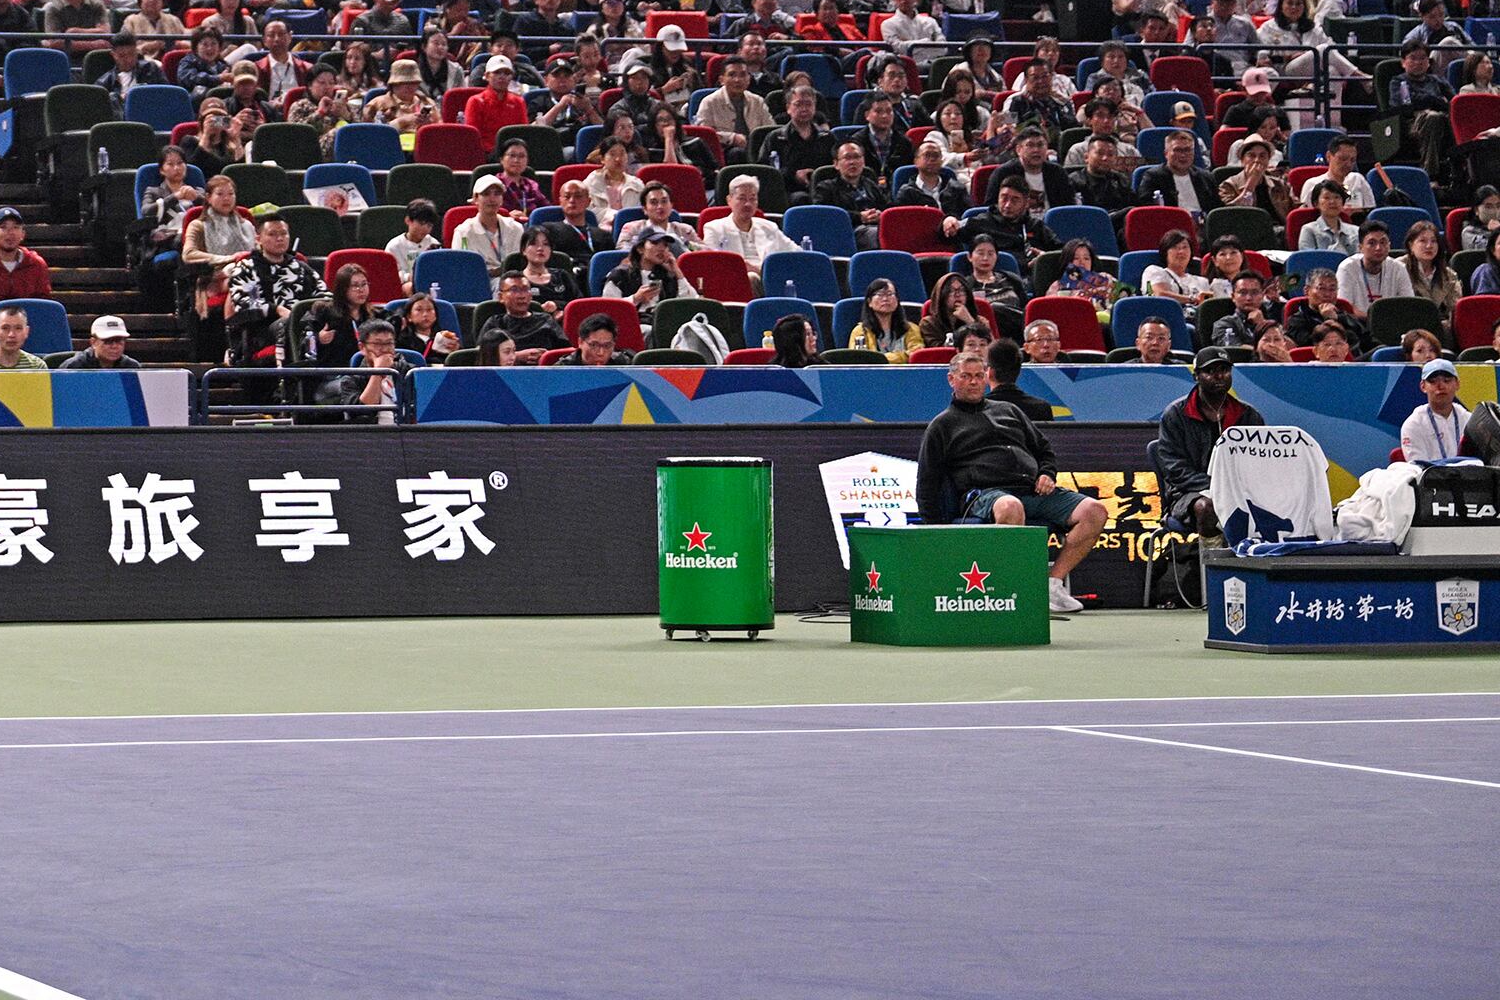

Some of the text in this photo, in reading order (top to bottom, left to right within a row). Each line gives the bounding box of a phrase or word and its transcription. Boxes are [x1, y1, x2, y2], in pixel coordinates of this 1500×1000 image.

[852, 478, 900, 487] ROLEX
[840, 490, 915, 500] SHANGHA
[1431, 502, 1500, 519] HEA
[665, 552, 738, 569] Heineken
[855, 594, 894, 613] Heineken
[934, 595, 1017, 612] Heineken
